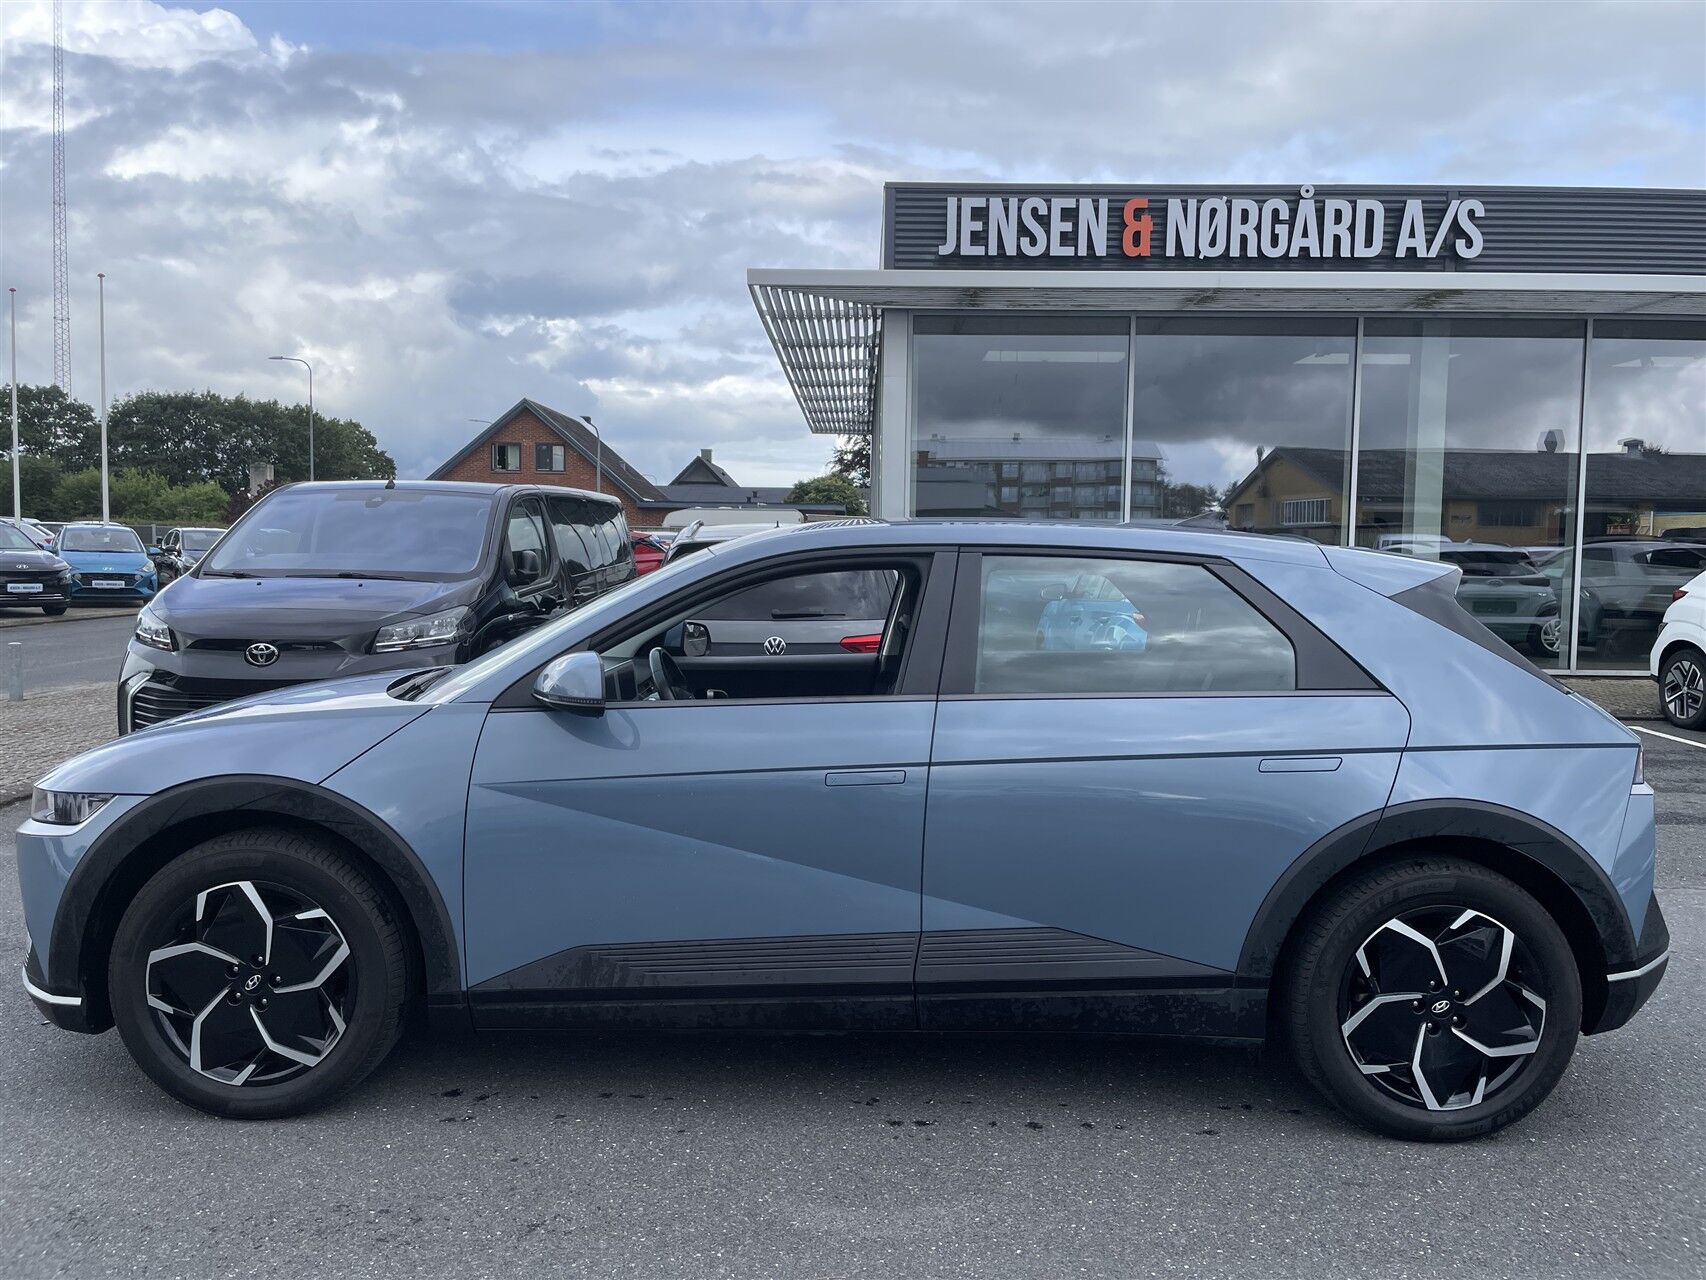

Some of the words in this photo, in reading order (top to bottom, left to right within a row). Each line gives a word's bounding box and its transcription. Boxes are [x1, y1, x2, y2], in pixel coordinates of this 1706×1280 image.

[938, 197, 1108, 256] JENSEN
[1123, 199, 1153, 257] &
[1165, 185, 1385, 259] NØRGÅRD
[1396, 199, 1485, 259] A/S
